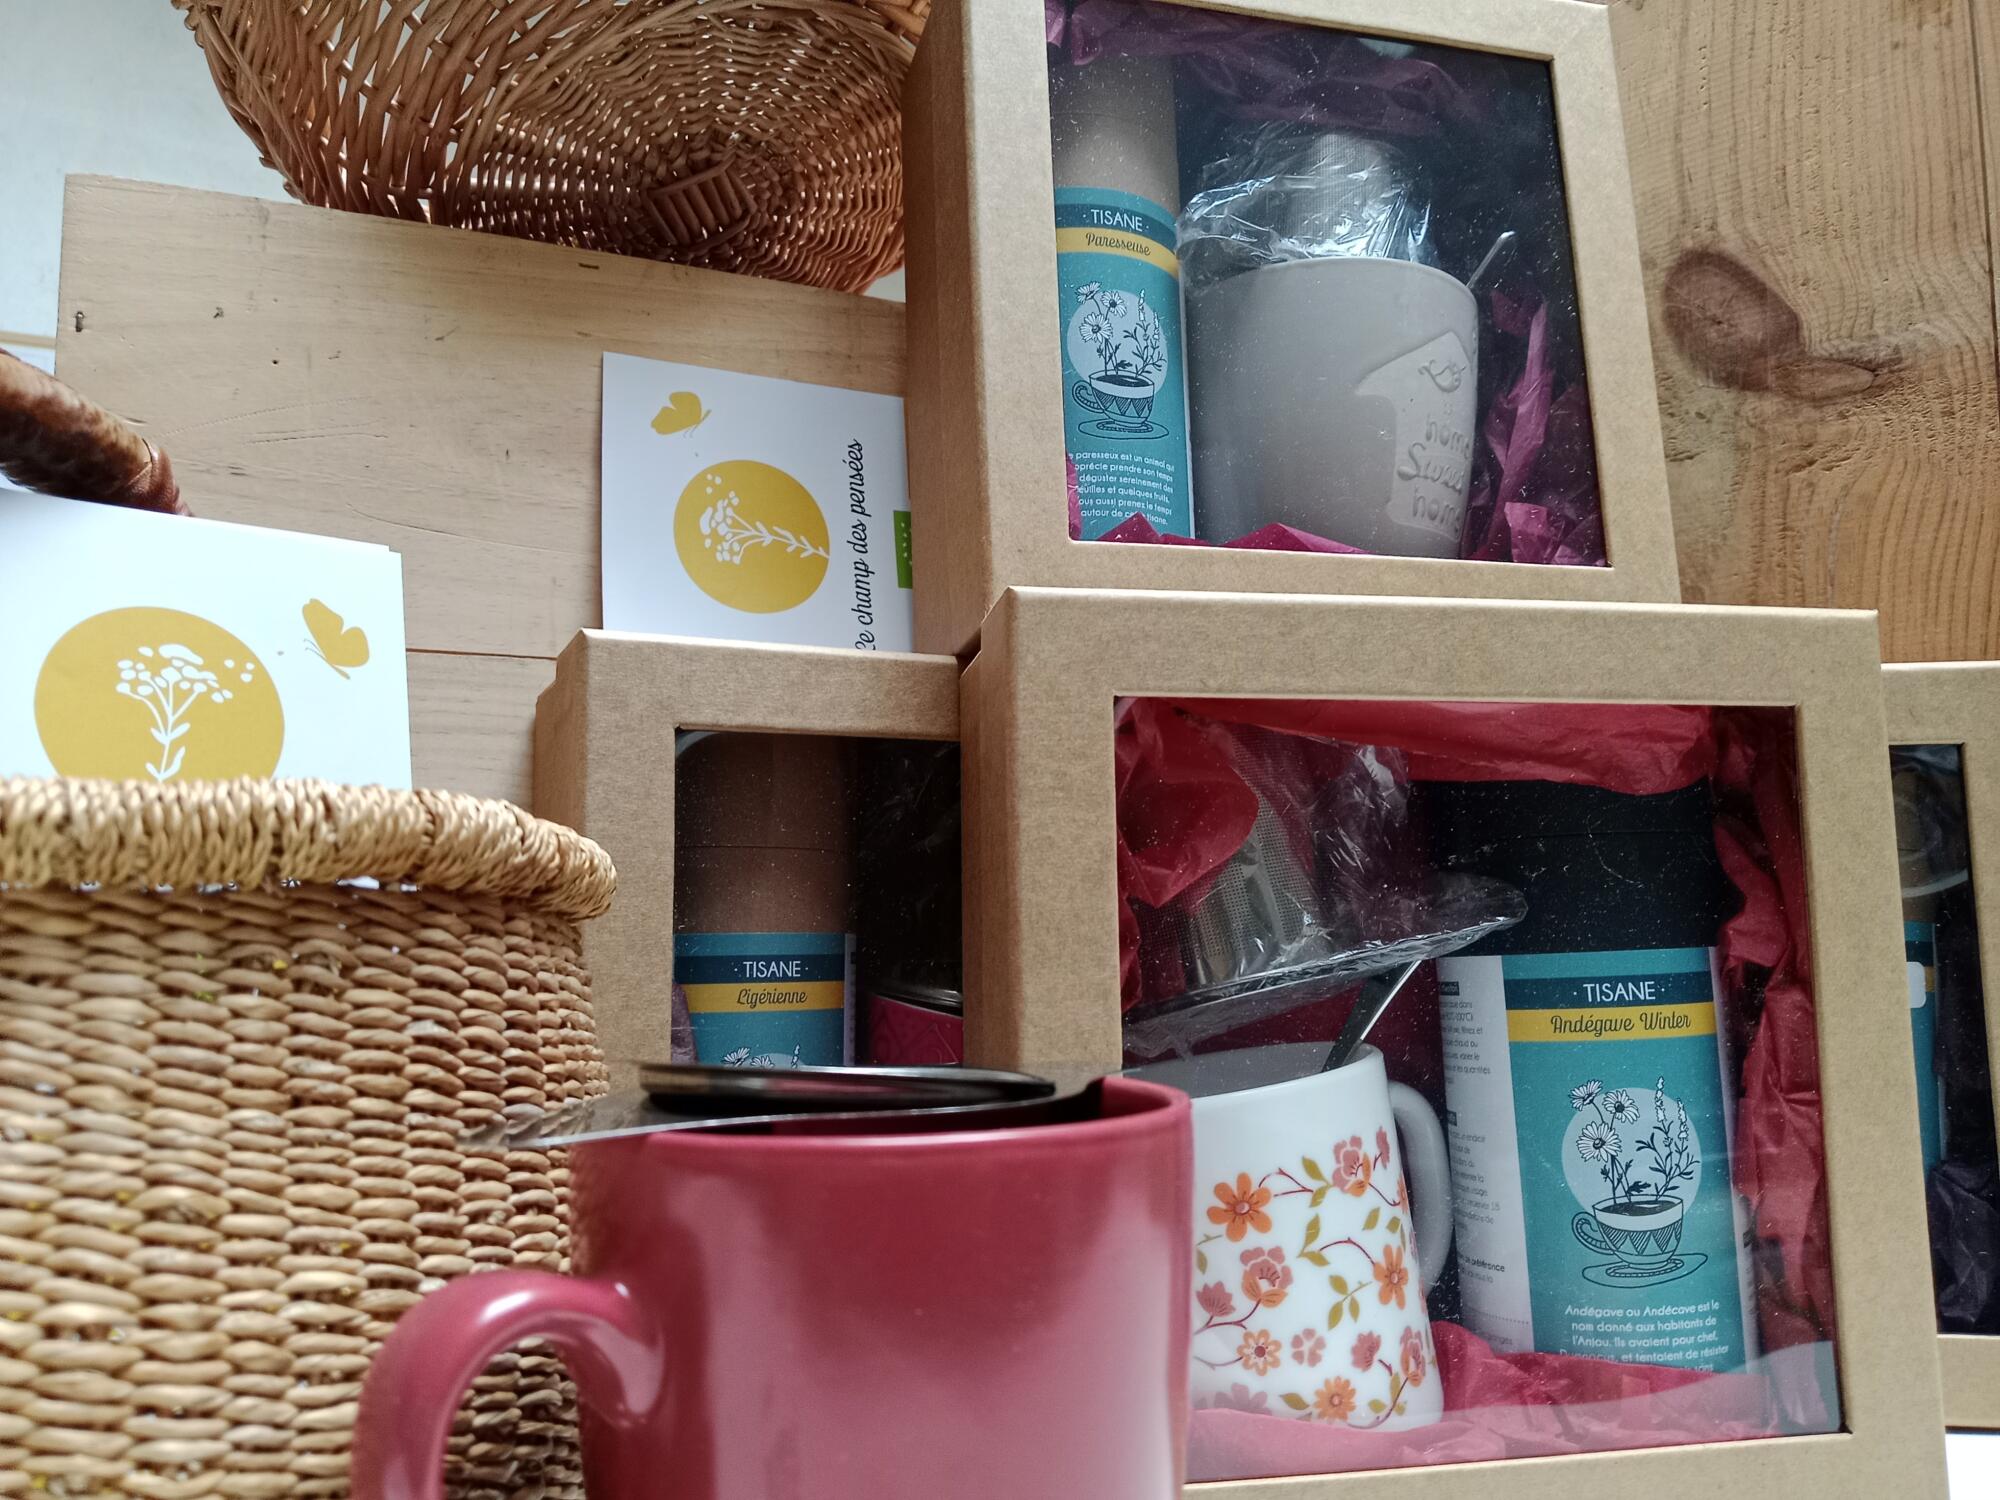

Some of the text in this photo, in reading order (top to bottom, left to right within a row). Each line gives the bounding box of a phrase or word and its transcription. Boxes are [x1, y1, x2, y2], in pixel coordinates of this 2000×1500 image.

[1090, 209, 1143, 232] TISANE
[1085, 232, 1151, 256] Paresseuse
[1075, 452, 1119, 462] paresseux
[1120, 453, 1132, 461] est
[1133, 455, 1143, 463] un
[842, 438, 873, 518] pensées
[1109, 463, 1142, 474] prendre
[1156, 470, 1173, 482] temps
[1079, 474, 1174, 494] déguster sereinement des
[1107, 486, 1116, 494] et
[1118, 486, 1153, 499] quelques
[1080, 508, 1110, 517] autour
[1111, 508, 1123, 517] de
[1095, 498, 1116, 506] aussi
[1118, 499, 1145, 509] prenez
[1146, 501, 1153, 509] le
[1154, 504, 1172, 516] temps
[846, 519, 868, 555] des
[850, 558, 876, 626] champ
[743, 960, 801, 978] TISANE
[736, 988, 808, 1009] Ligérienne
[1582, 981, 1656, 1002] TISANE
[1550, 1012, 1691, 1038] Andégave Winter
[1564, 1299, 1720, 1318] Andégave ou Andécave est le
[1571, 1315, 1717, 1333] nom donné aux habitants de
[1614, 1335, 1626, 1347] Ils
[1628, 1336, 1670, 1348] avaient
[1672, 1335, 1695, 1347] pour
[1621, 1351, 1633, 1362] et
[1635, 1349, 1683, 1362] tentaient
[1685, 1349, 1699, 1360] de
